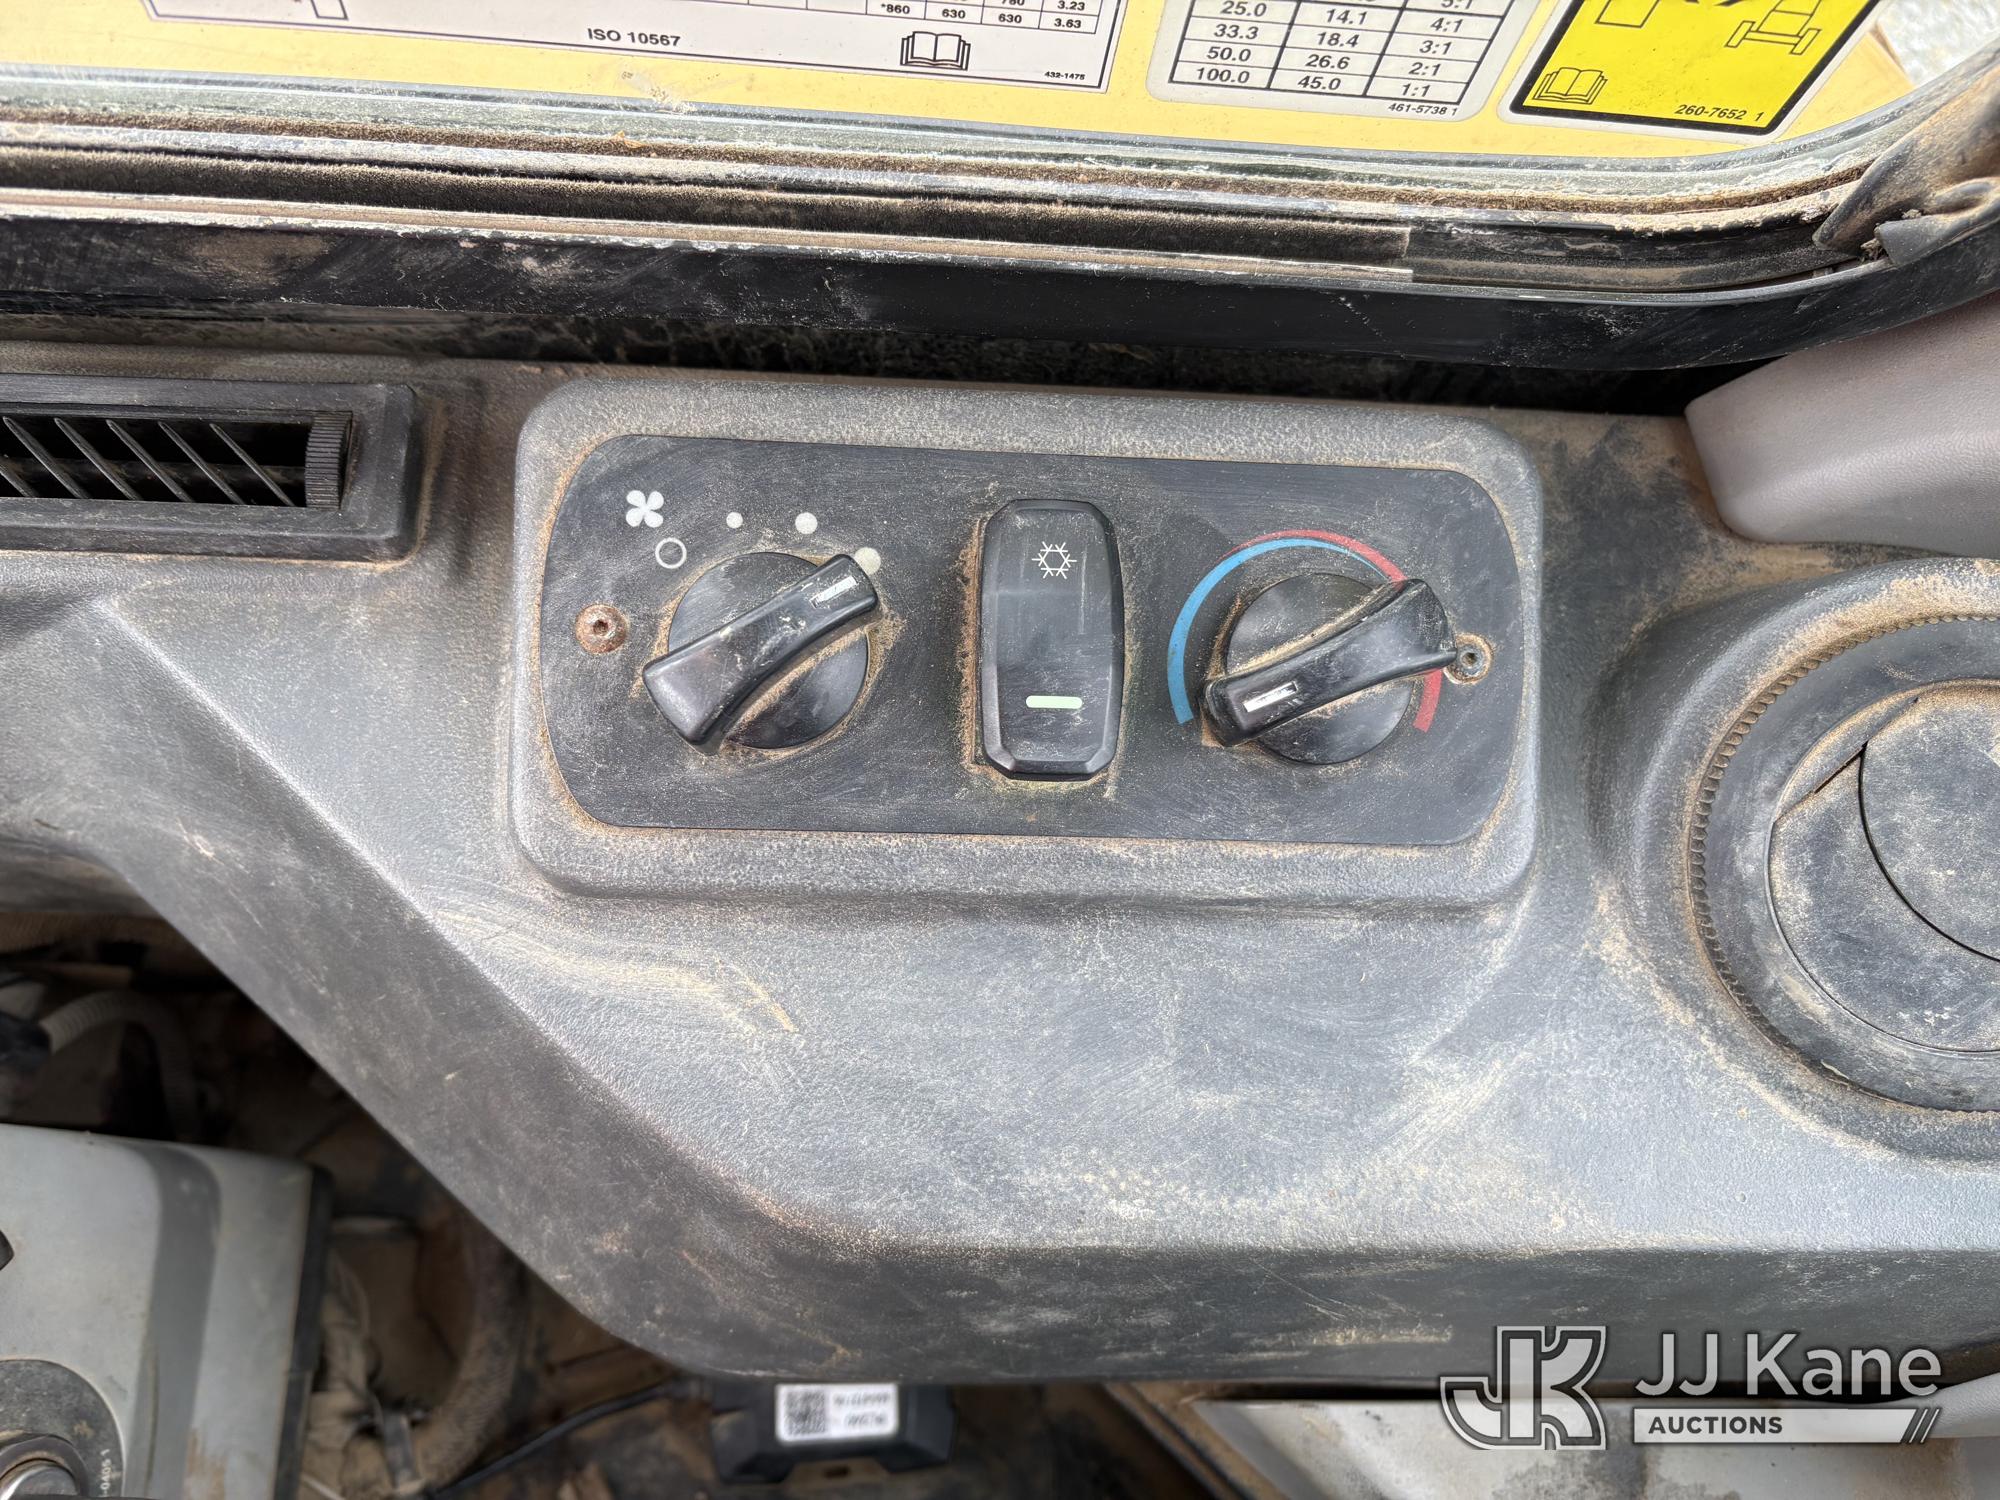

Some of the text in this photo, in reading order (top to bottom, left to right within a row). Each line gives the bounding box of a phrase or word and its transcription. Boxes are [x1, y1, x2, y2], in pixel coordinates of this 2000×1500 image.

[1057, 0, 1085, 11] 3.23
[1220, 0, 1267, 17] 25.0
[941, 8, 966, 19] 630
[998, 13, 1023, 24] 630
[1053, 17, 1082, 29] 3.63
[1325, 9, 1463, 34] 14.1 4:1
[587, 28, 681, 47] ISO 10567
[1213, 23, 1453, 56] 33.3 18.4 3:1
[1206, 46, 1442, 78] 50.0 26.6 2:1
[1196, 68, 1431, 98] 100.0 45.0 1:1
[1388, 102, 1458, 116] 461-5738 1
[1675, 104, 1764, 122] 260-7652 1
